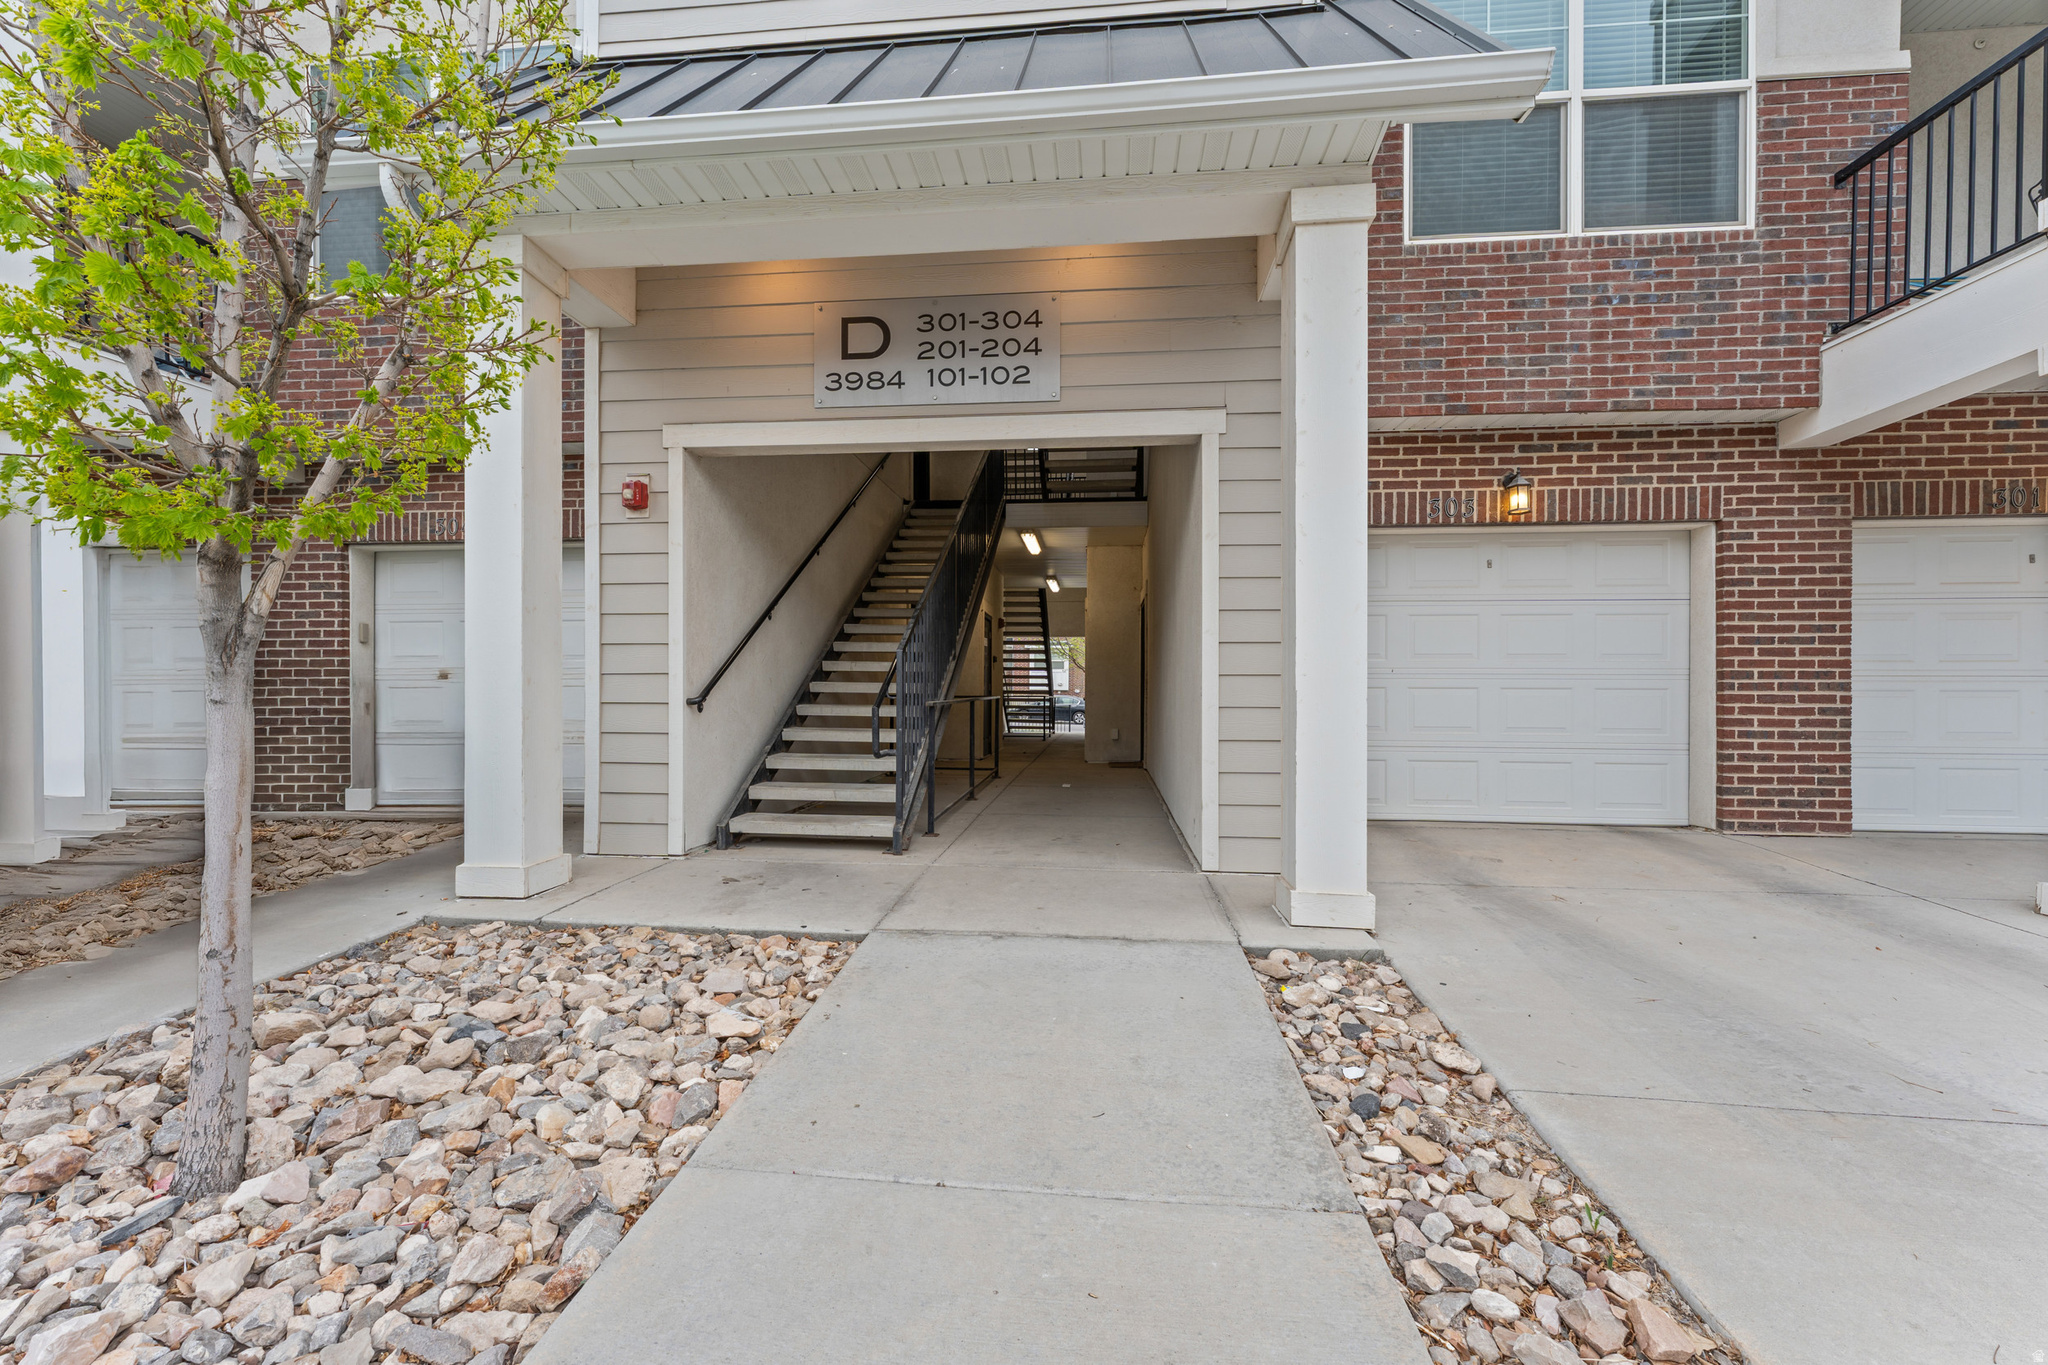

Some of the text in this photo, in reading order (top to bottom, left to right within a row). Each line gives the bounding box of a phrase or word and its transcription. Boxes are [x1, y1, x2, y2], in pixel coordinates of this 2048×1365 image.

[916, 309, 1043, 333] 301-304
[841, 316, 891, 361] D
[917, 337, 1042, 360] 201-204
[825, 370, 905, 392] 3984
[927, 365, 1031, 387] 101-102
[1428, 497, 1475, 518] 303
[1992, 487, 2039, 509] 301
